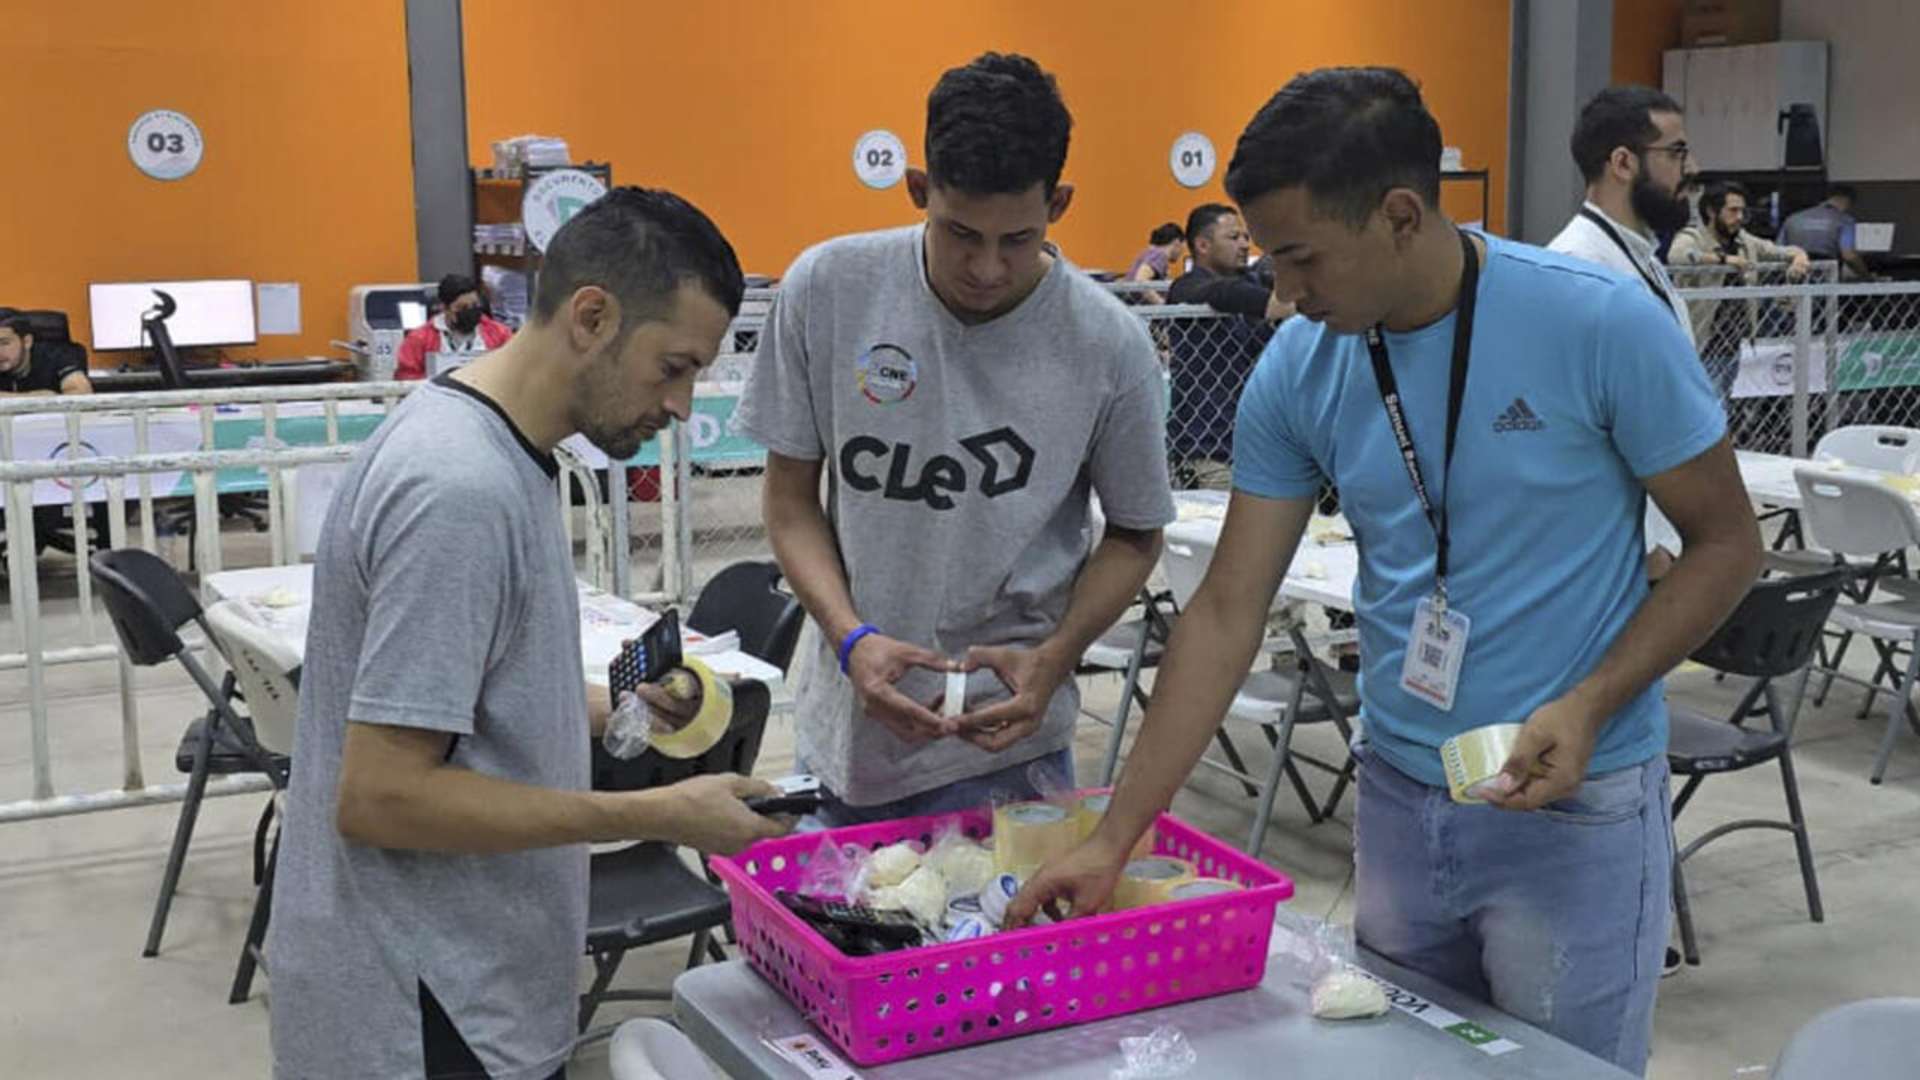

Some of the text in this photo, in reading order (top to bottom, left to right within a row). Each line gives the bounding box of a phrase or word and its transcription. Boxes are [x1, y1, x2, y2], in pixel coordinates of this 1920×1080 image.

[147, 132, 184, 154] 03
[867, 149, 893, 167] 02
[1182, 150, 1203, 168] 01
